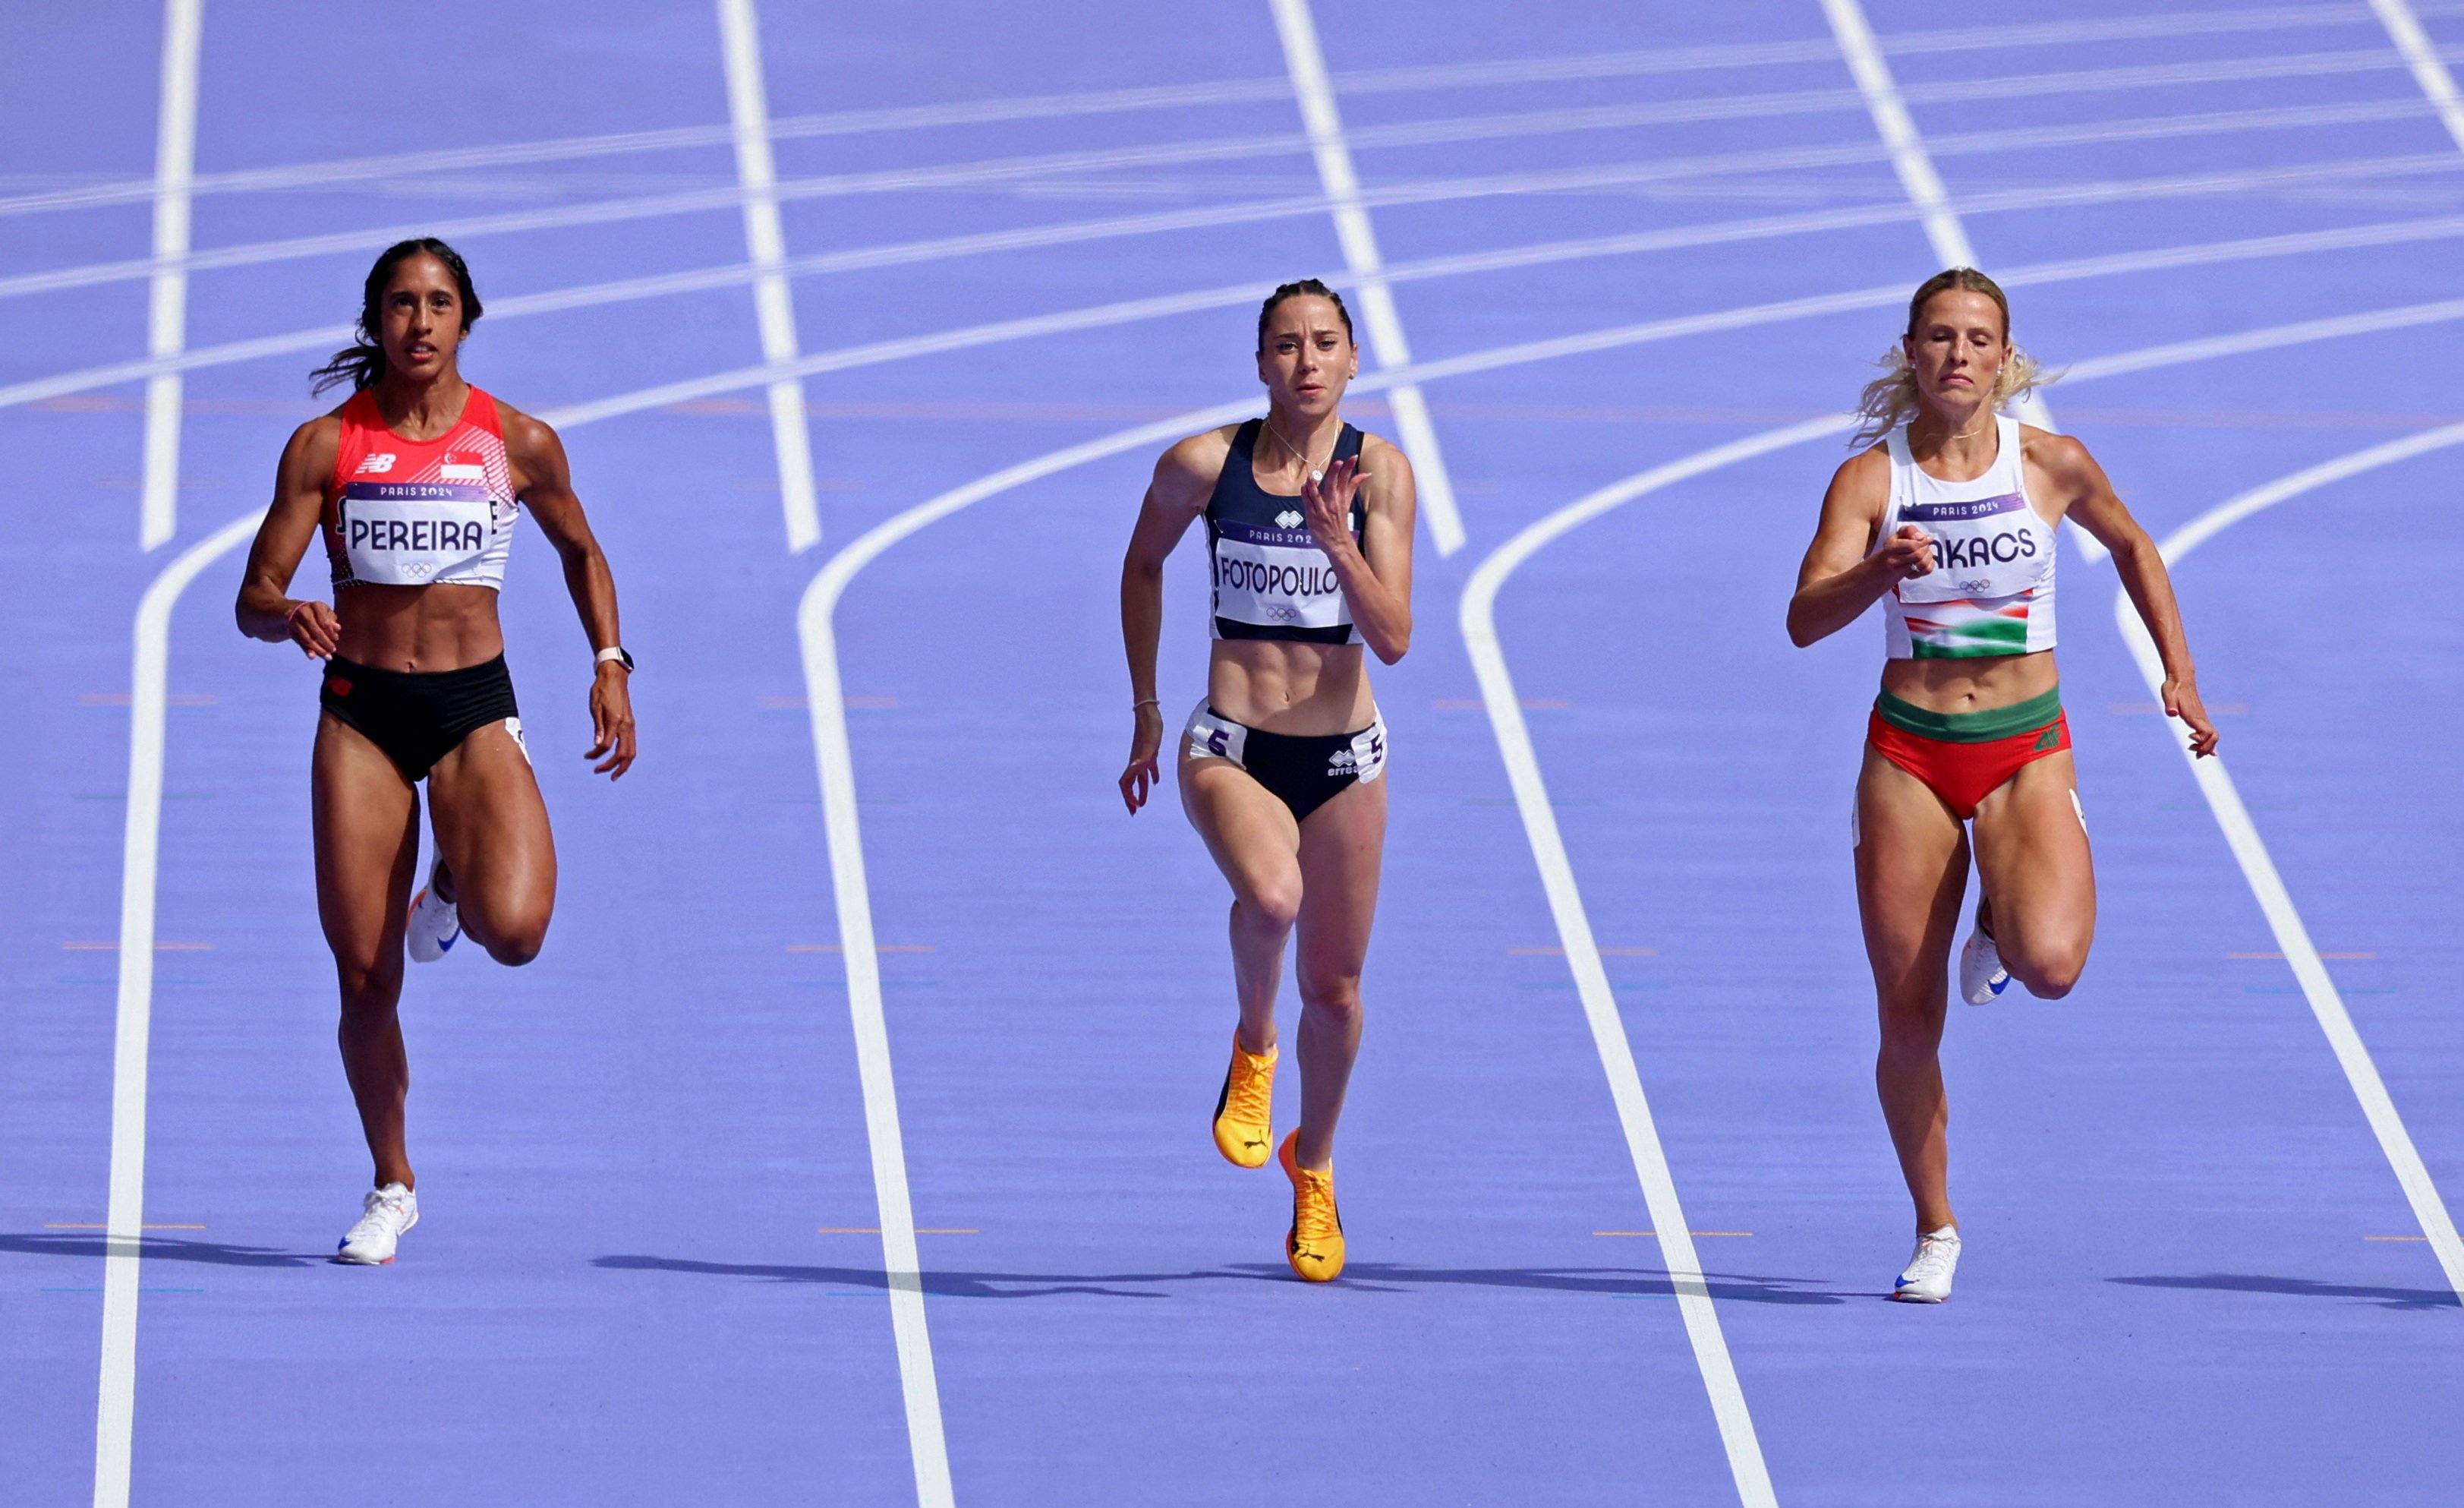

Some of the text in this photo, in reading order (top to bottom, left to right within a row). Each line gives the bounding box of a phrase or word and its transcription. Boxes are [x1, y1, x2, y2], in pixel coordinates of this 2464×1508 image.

[380, 487, 452, 497] PARIS 2024
[1933, 501, 1999, 516] PARIS 2024
[351, 519, 483, 551] PEREIRA
[1249, 530, 1312, 544] PARIS 202
[1928, 528, 2036, 569] AKACS
[1221, 557, 1340, 597] FOTOPOULO
[1207, 729, 1230, 757] 5
[1370, 733, 1383, 764] 5
